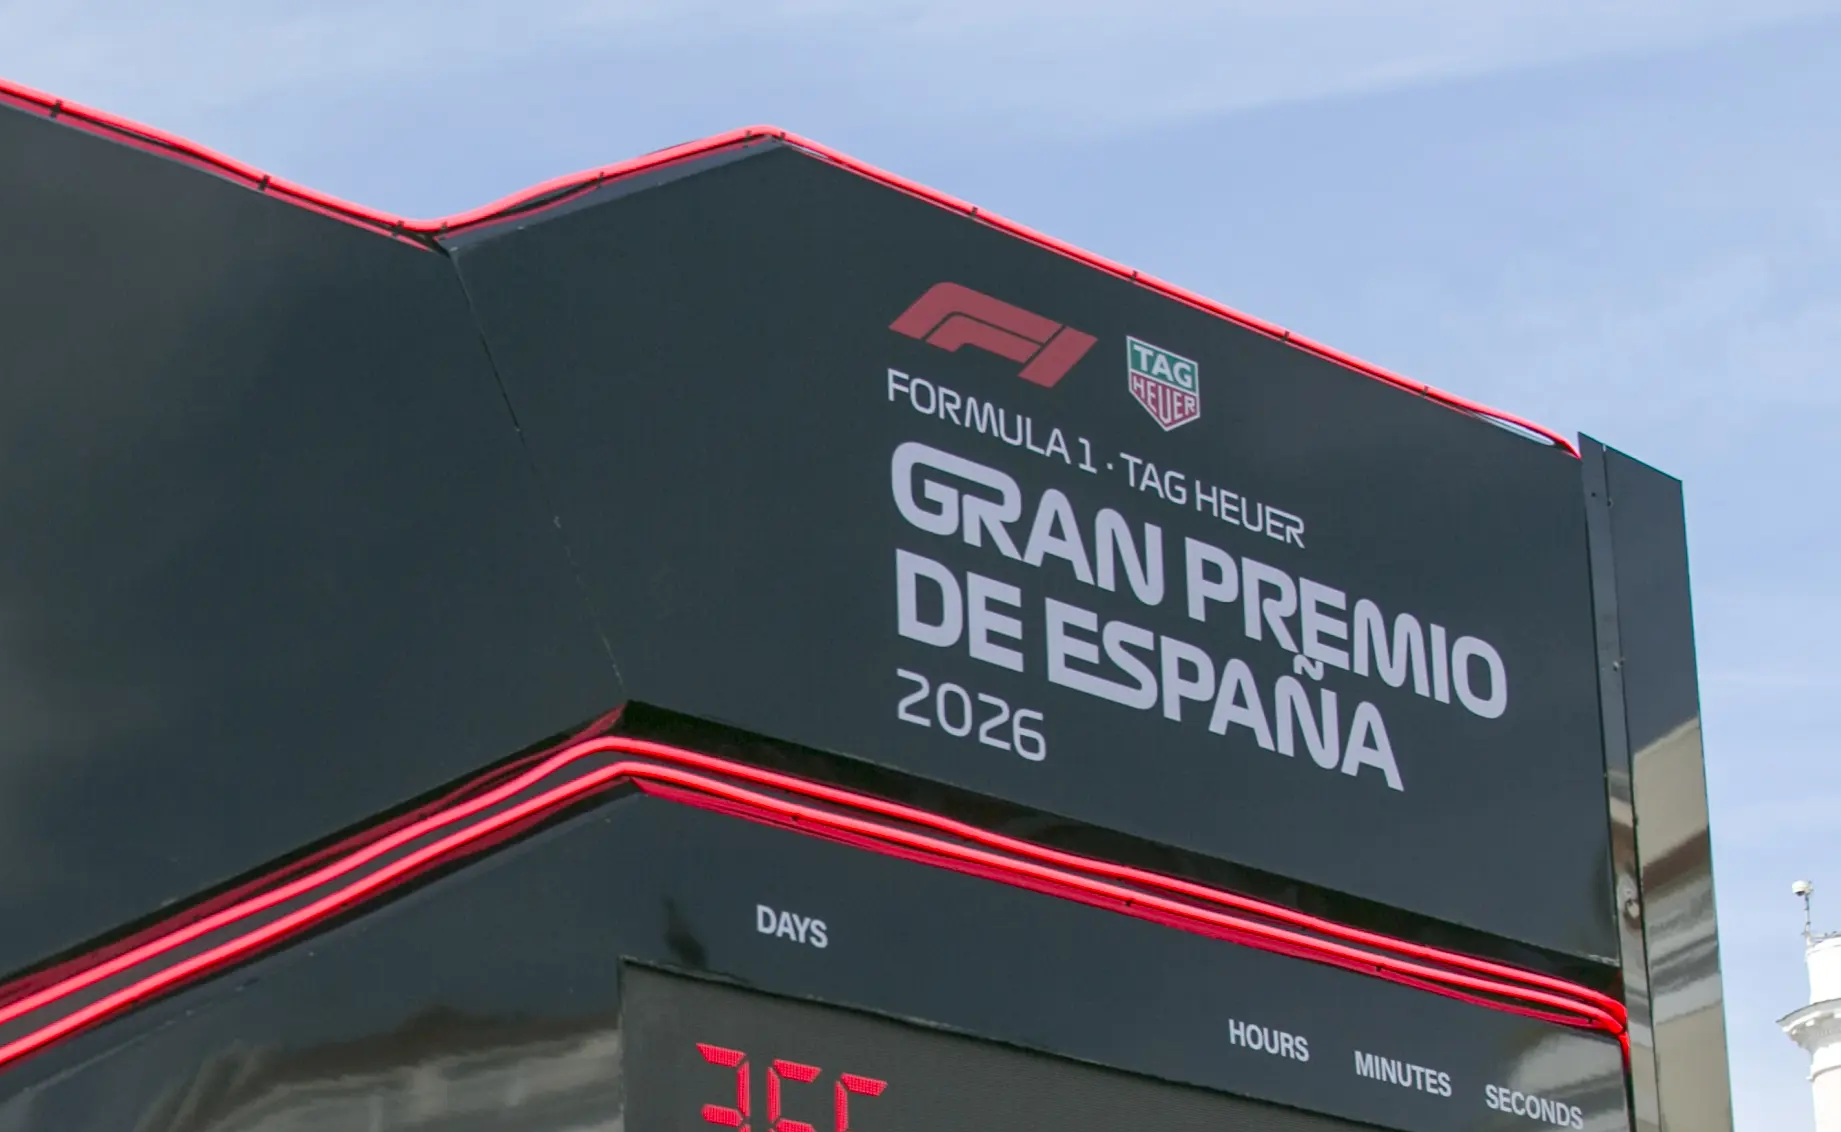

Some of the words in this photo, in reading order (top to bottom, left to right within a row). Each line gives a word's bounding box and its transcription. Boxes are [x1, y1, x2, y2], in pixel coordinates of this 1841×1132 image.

[1132, 343, 1193, 389] TAG
[1133, 375, 1196, 424] HEUER
[887, 368, 1071, 465] FORMULA
[1078, 437, 1098, 474] 1
[1119, 452, 1187, 505] TAG
[1195, 480, 1306, 549] HEUER
[891, 441, 1165, 607] GRAN
[1185, 537, 1508, 720] PREMIO
[895, 549, 1025, 673] DE
[1045, 597, 1405, 793] ESPAÑA
[896, 668, 1047, 762] 2026
[756, 903, 829, 949] DAYS
[1228, 1018, 1310, 1063] HOURS
[1353, 1050, 1453, 1098] MINUTES
[1485, 1084, 1584, 1131] SECONDS
